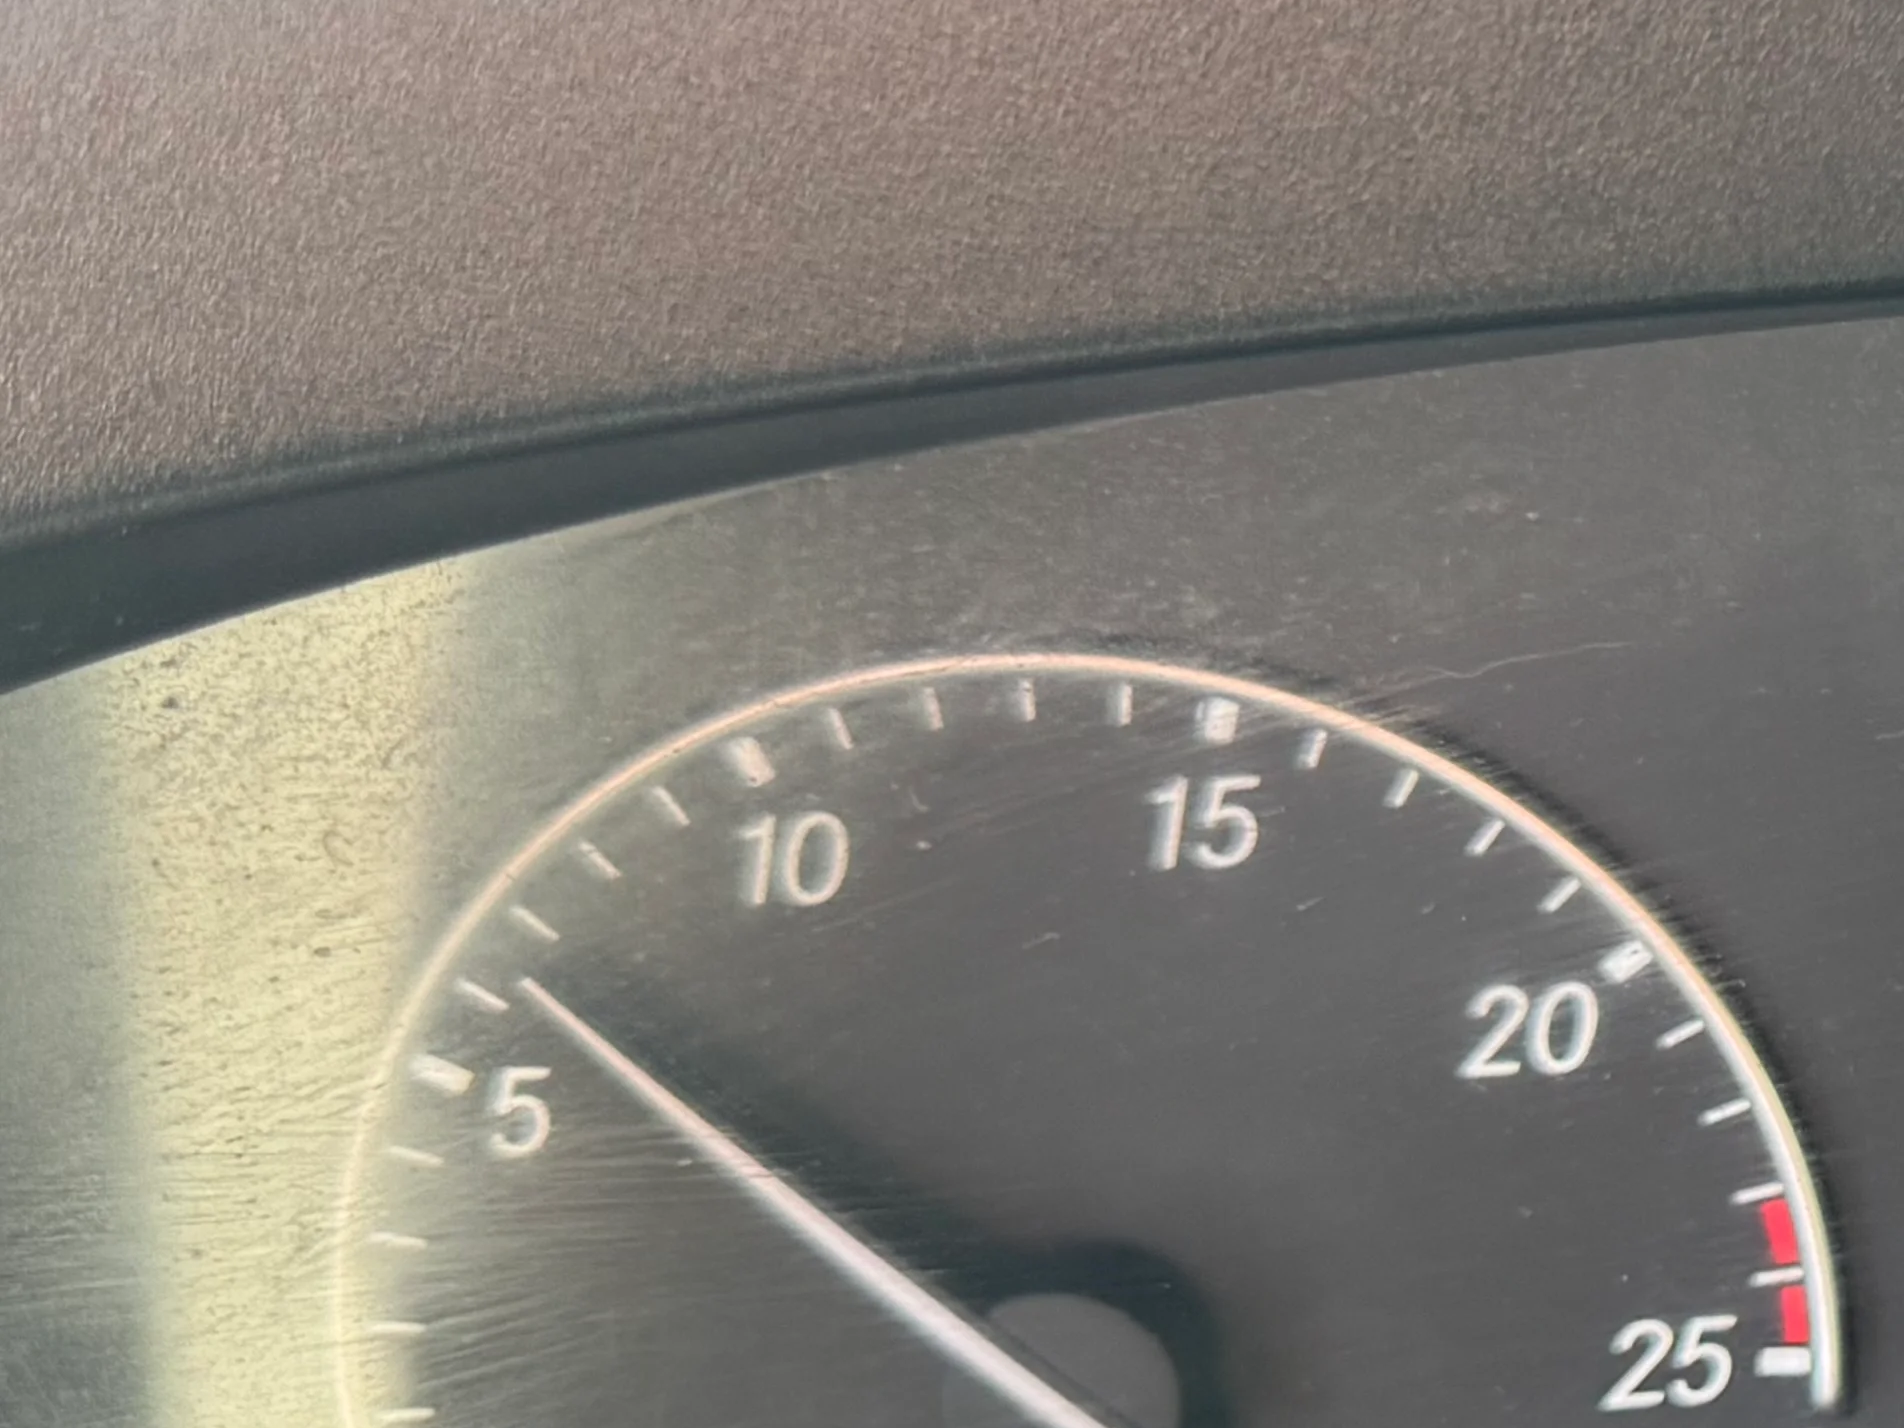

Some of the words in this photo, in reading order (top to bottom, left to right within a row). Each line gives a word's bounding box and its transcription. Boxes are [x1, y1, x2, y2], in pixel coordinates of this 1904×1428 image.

[736, 808, 852, 907] 10
[1146, 773, 1262, 872] 15
[1456, 980, 1601, 1081] 20
[486, 1064, 554, 1159] 5
[1598, 1314, 1738, 1413] 25
